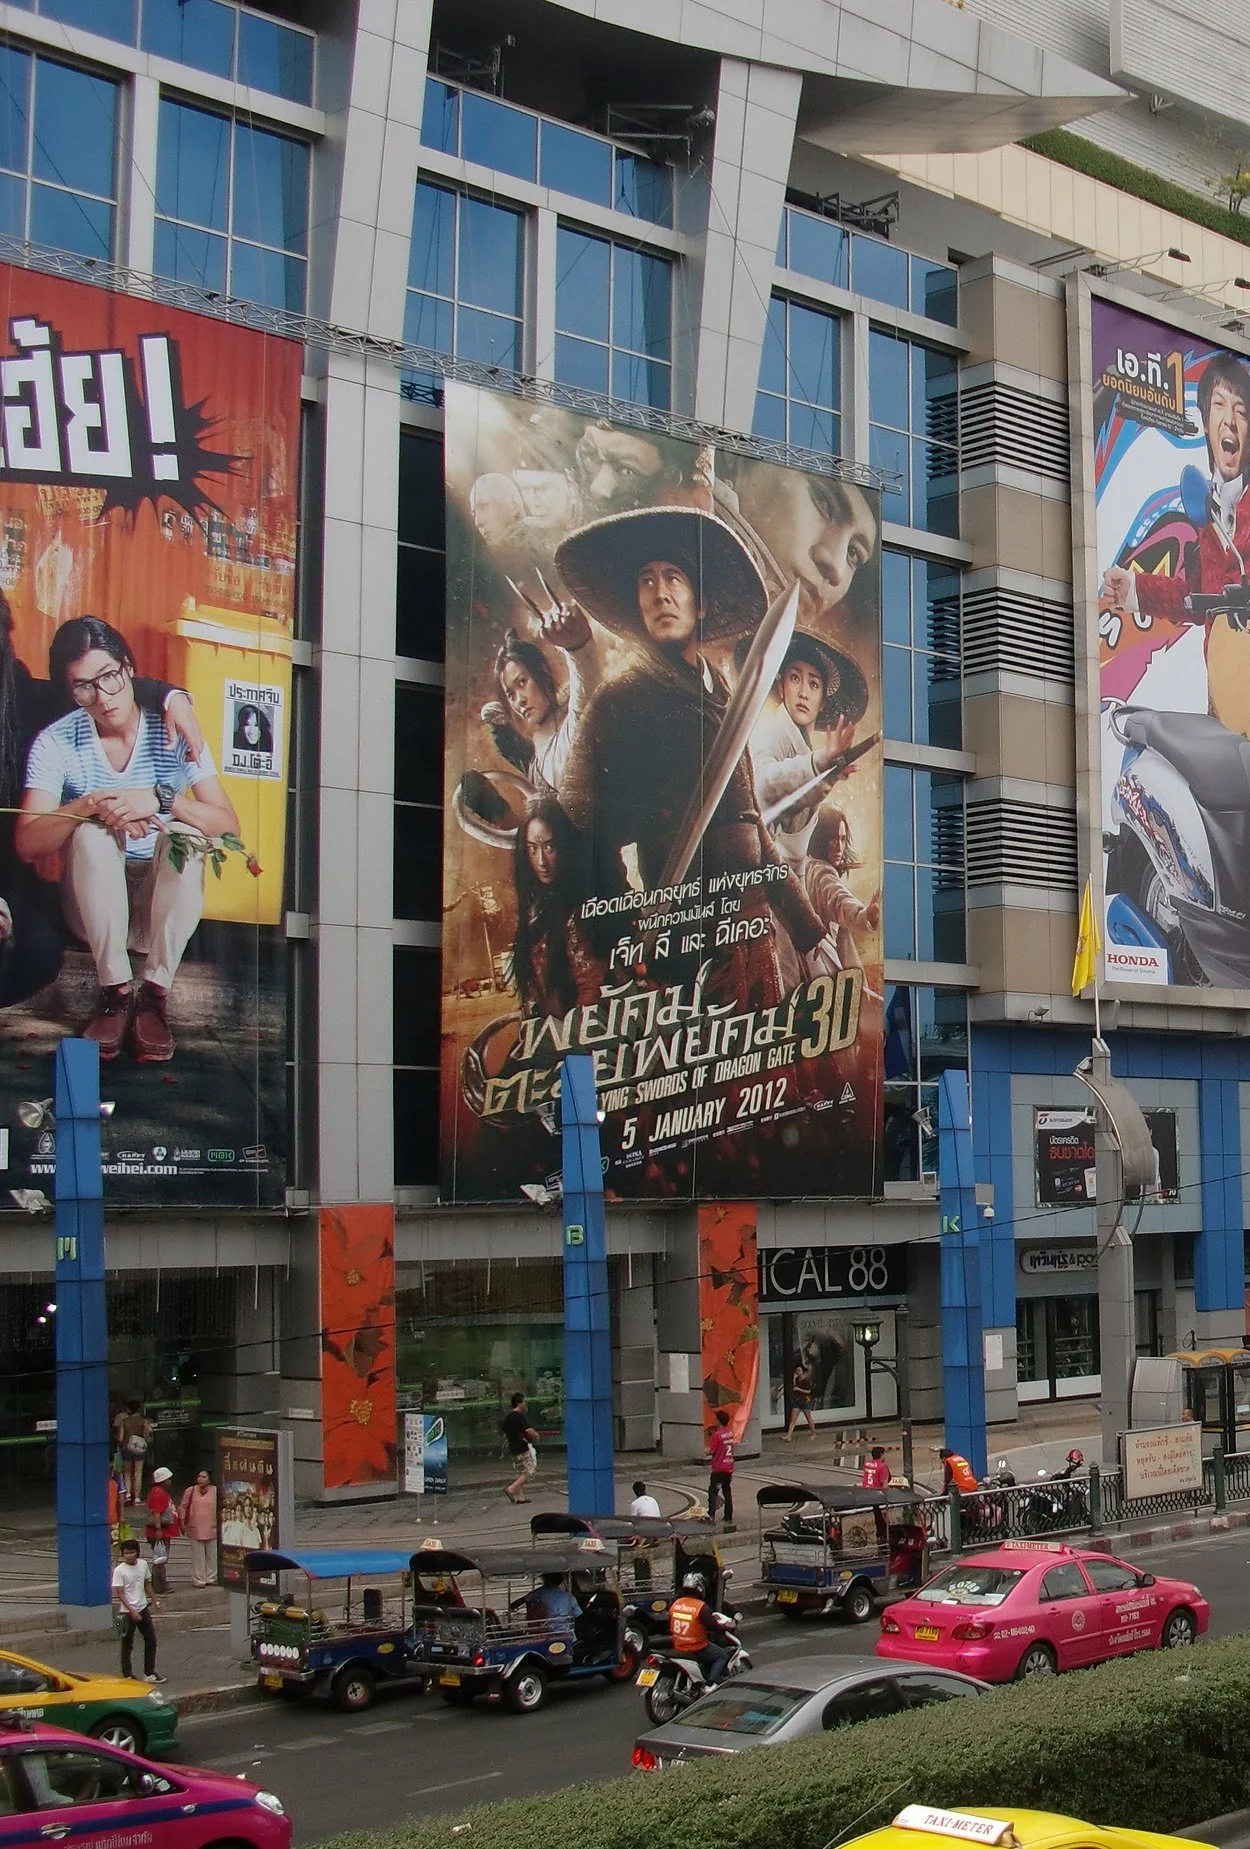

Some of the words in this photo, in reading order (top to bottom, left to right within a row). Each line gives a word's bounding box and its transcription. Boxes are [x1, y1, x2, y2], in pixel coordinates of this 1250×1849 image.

[1102, 373, 1176, 410] ยอดนิยมอันดับ
[1167, 351, 1184, 415] 1
[720, 896, 741, 915] โดย
[609, 935, 644, 970] เจ็ท
[654, 929, 671, 960] ลี
[680, 933, 706, 955] และ
[1107, 953, 1159, 967] HONDA
[799, 967, 863, 1060] 3D
[635, 1071, 687, 1105] SWORDS
[692, 1067, 708, 1088] OF
[714, 1054, 760, 1085] DRAGON
[767, 1046, 796, 1069] GATE
[622, 1118, 637, 1150] 5
[648, 1093, 726, 1143] JANUARY
[737, 1077, 788, 1119] 2012
[942, 1215, 961, 1234] K
[848, 1246, 889, 1291] 88
[725, 1445, 732, 1456] 2
[673, 1619, 690, 1635] 87
[922, 1813, 996, 1836] TAXI-METER
